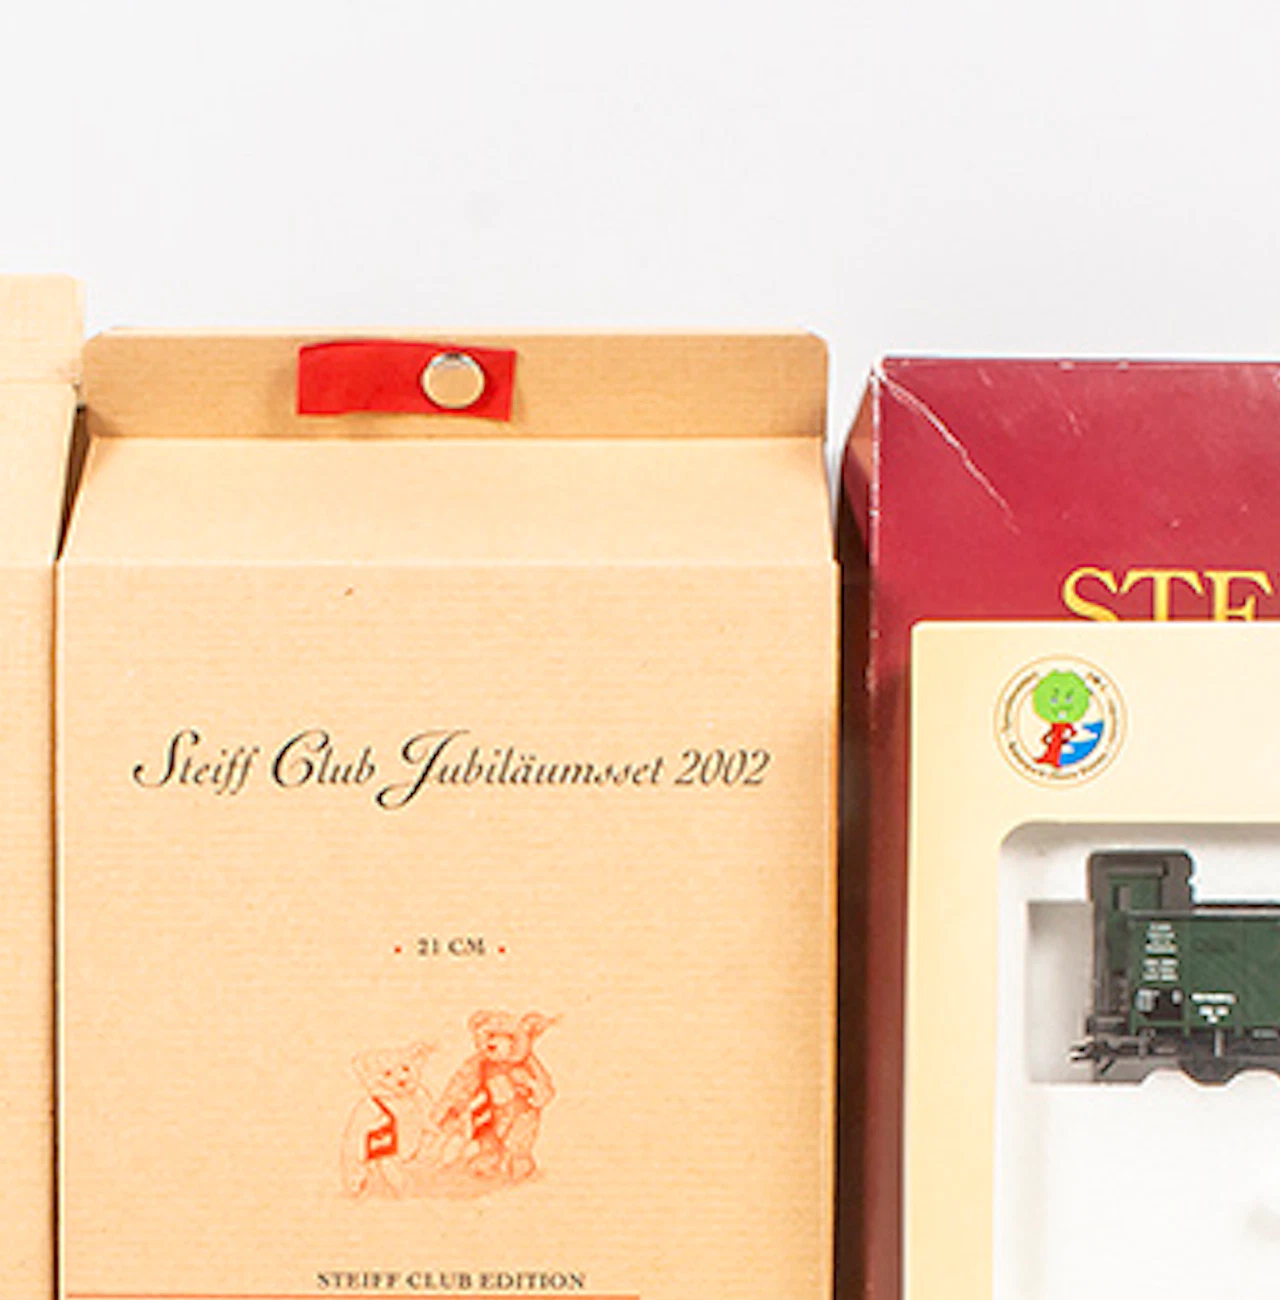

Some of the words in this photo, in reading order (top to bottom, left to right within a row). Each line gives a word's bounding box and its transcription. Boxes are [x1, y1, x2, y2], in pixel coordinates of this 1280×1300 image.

[133, 729, 261, 796] Steiff
[270, 729, 376, 788] Club
[375, 729, 663, 810] Jubiläumsset
[675, 749, 771, 786] 2002
[417, 937, 440, 957] 21
[447, 937, 486, 957] CM
[317, 1271, 399, 1289] STEIFF
[406, 1271, 472, 1289] CLUB
[479, 1272, 586, 1290] EDITION
